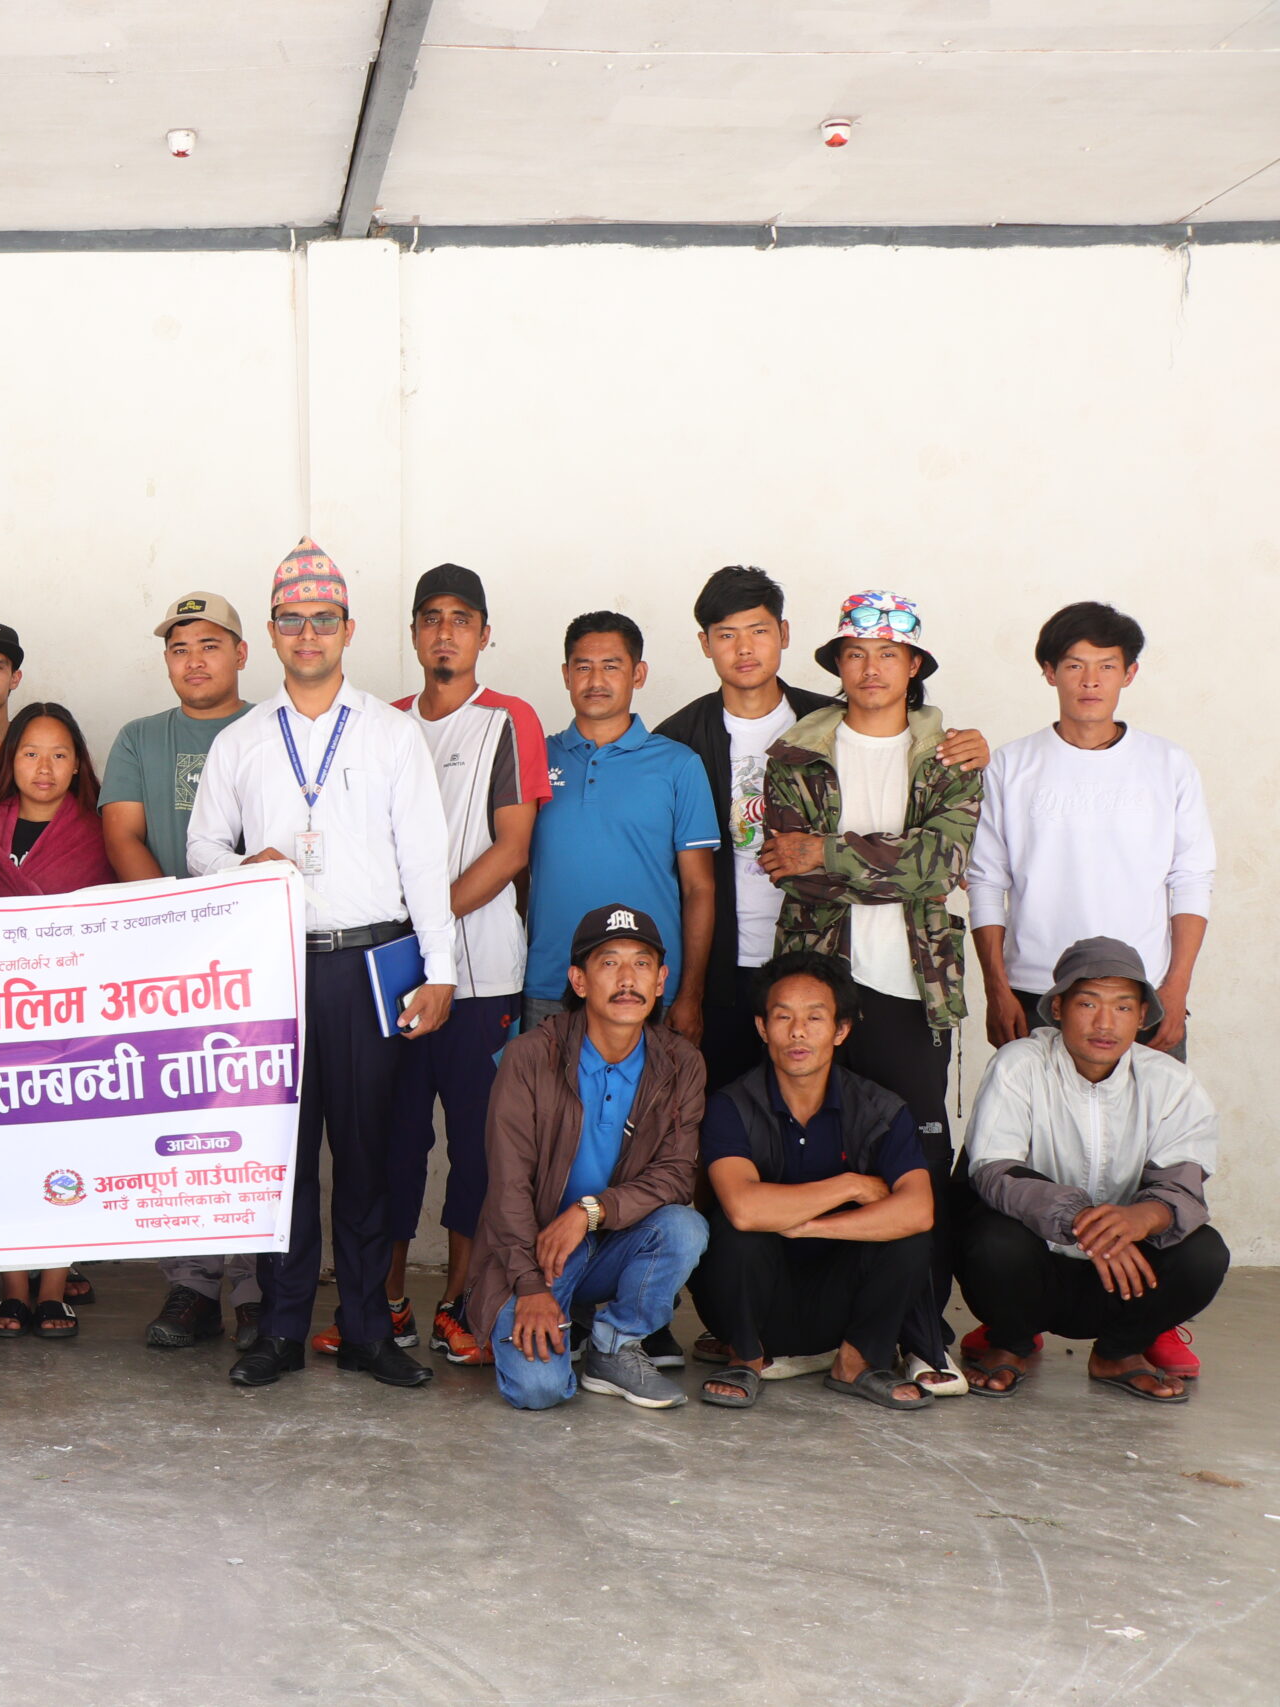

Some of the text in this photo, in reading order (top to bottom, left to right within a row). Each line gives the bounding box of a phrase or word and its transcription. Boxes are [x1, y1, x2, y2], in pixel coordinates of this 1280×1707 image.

[80, 917, 107, 936] ऊर्जा
[110, 919, 120, 932] र
[99, 958, 254, 1022] अन्तर्गत
[158, 1031, 295, 1099] तालिम
[165, 1134, 233, 1153] आयोजक
[93, 1160, 289, 1194] अन्नपूर्ण गाउँपालिक
[102, 1194, 132, 1211] गाउँ
[237, 1187, 283, 1203] कार्याल
